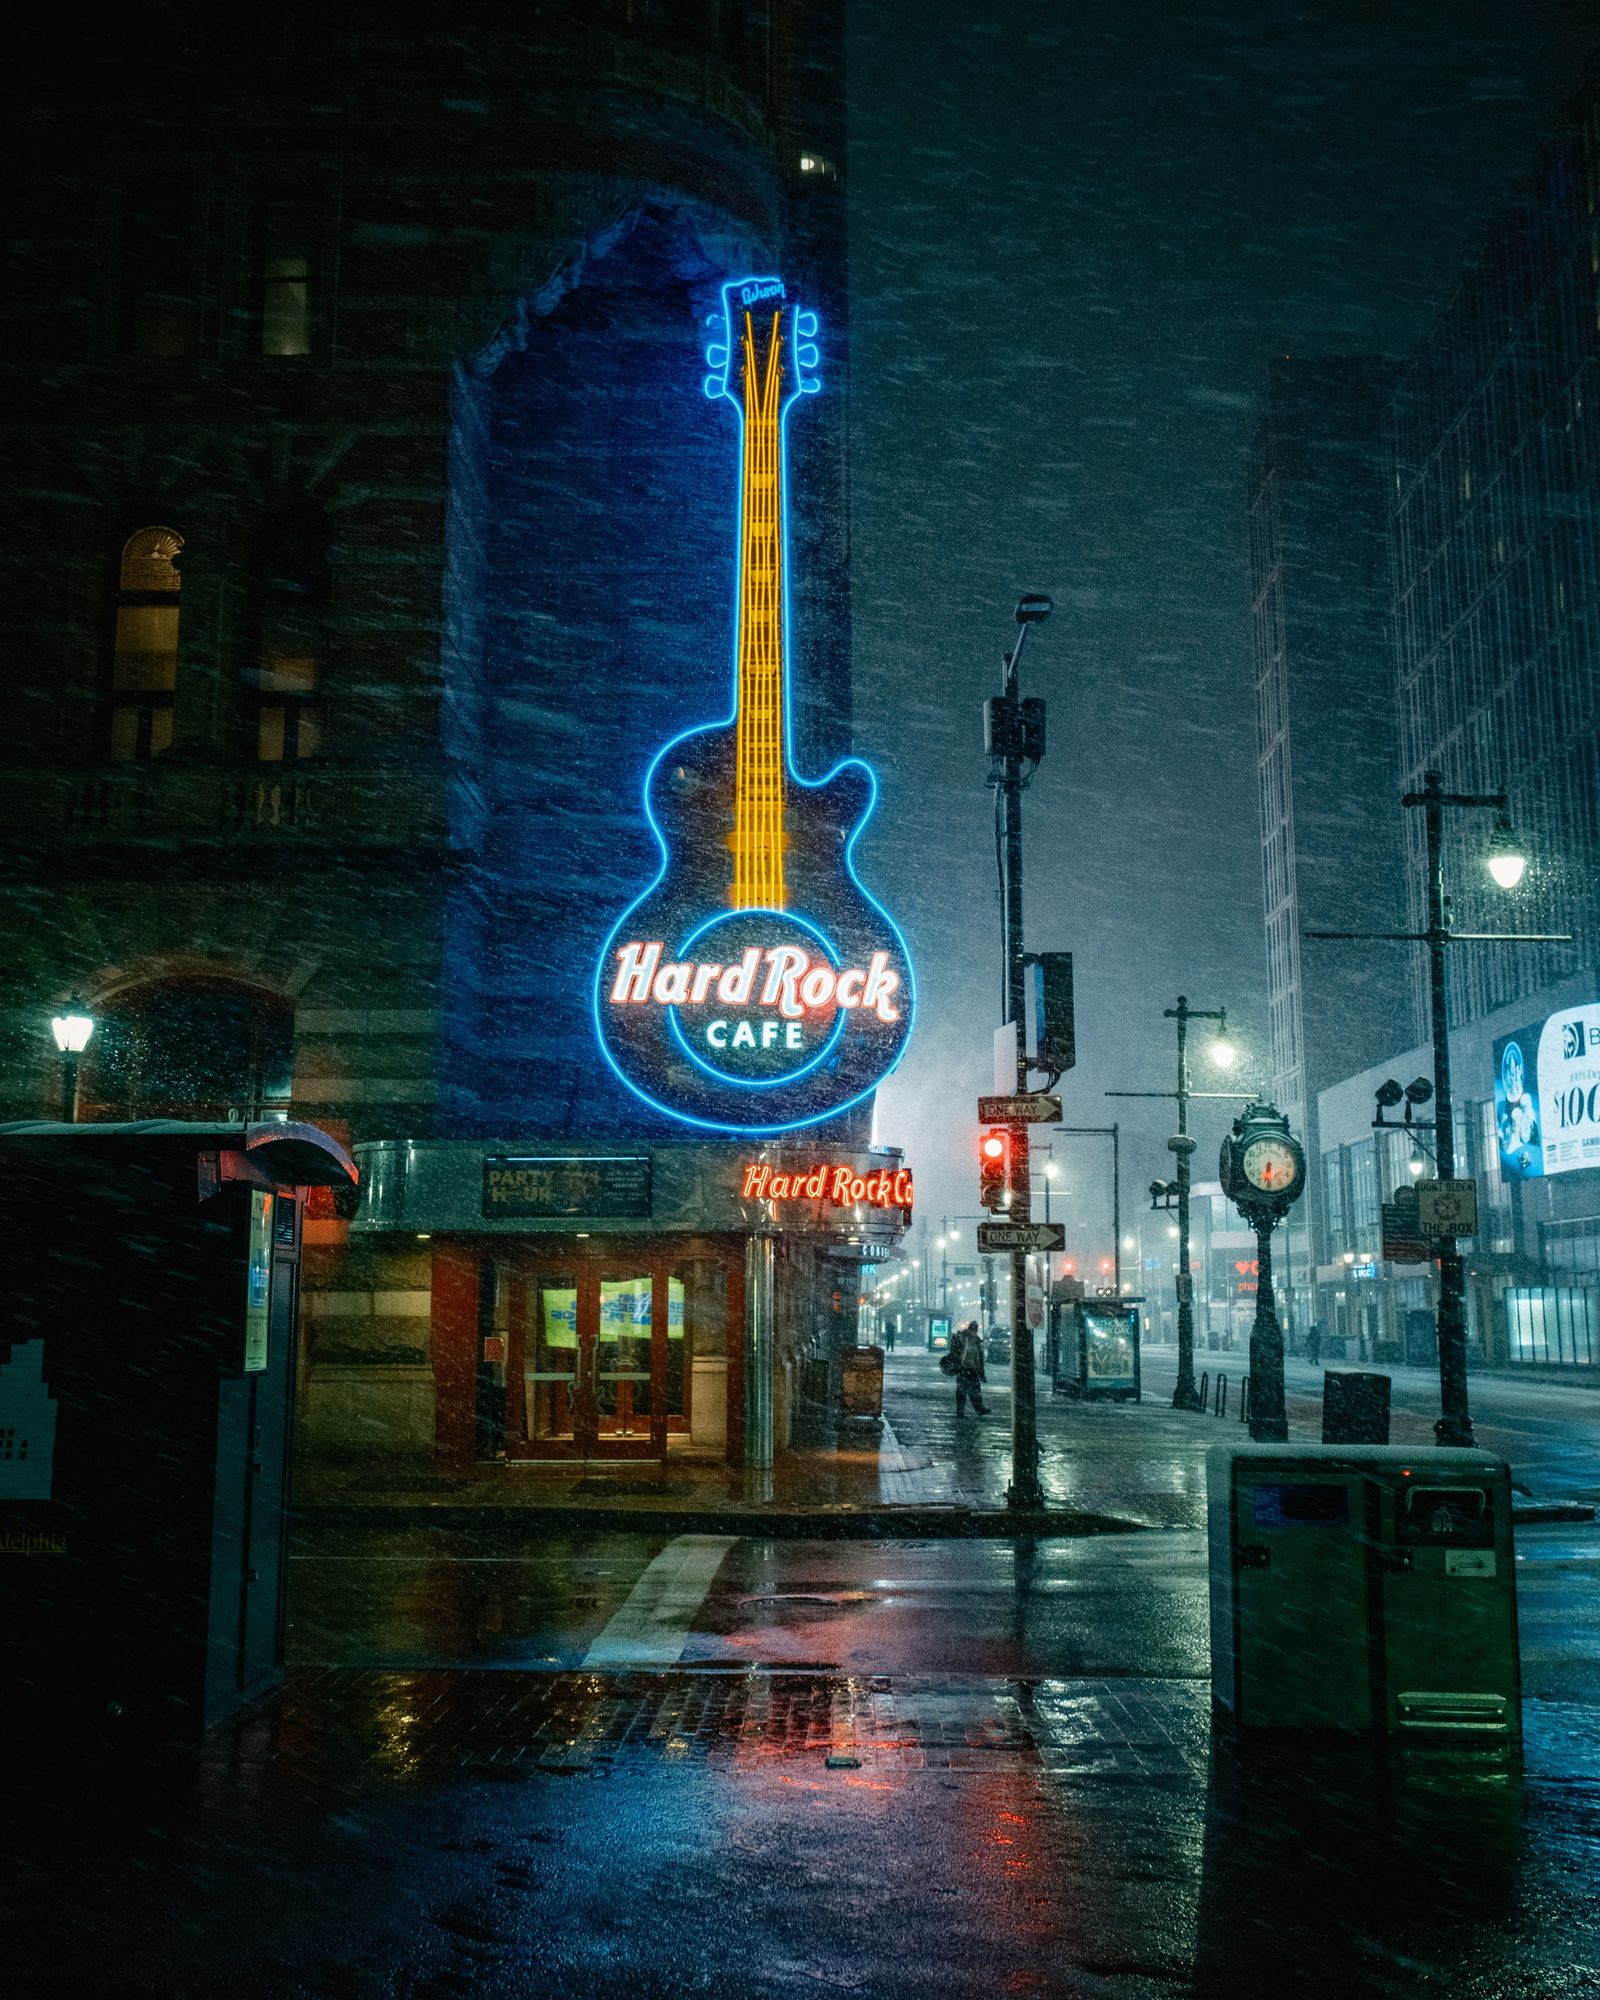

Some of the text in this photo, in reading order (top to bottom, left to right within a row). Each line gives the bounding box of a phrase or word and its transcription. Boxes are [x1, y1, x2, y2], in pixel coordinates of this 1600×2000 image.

[610, 941, 900, 1023] Hard Rock
[706, 1020, 803, 1049] CAFE
[988, 1103, 1038, 1116] ONE WAY
[489, 1170, 556, 1185] PARTY
[743, 1164, 828, 1199] Hard
[832, 1166, 892, 1208] Rock
[1422, 1222, 1473, 1234] THE BOX
[989, 1231, 1040, 1242] ONE WAY
